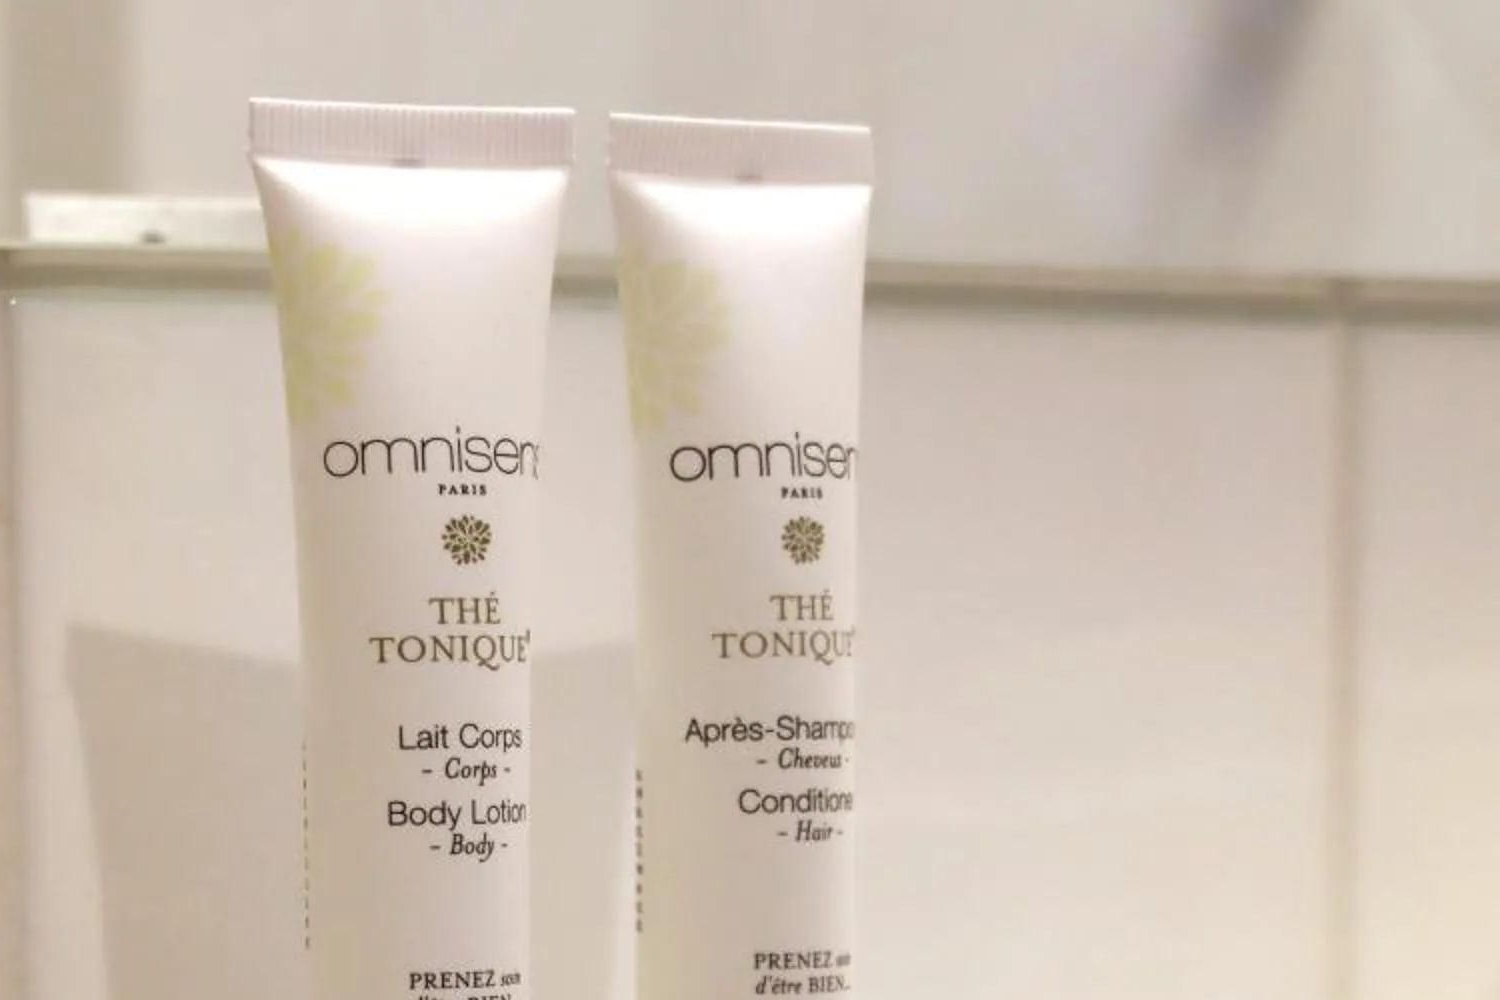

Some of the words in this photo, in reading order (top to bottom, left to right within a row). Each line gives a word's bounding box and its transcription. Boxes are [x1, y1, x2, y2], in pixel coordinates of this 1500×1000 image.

[322, 426, 539, 480] omnisen
[438, 483, 487, 496] PARIS
[781, 486, 823, 500] PARIS
[428, 592, 501, 625] THÉ
[769, 588, 834, 621] THÉ
[398, 724, 449, 750] Lait
[459, 723, 522, 752] Corps
[444, 757, 498, 787] Corps
[387, 800, 462, 831] Body
[471, 799, 527, 824] Lotion
[796, 820, 833, 843] Hair
[449, 832, 495, 863] Body
[753, 951, 833, 971] PRENEZ
[409, 968, 496, 990] PRENEZ
[755, 975, 802, 995] d'être
